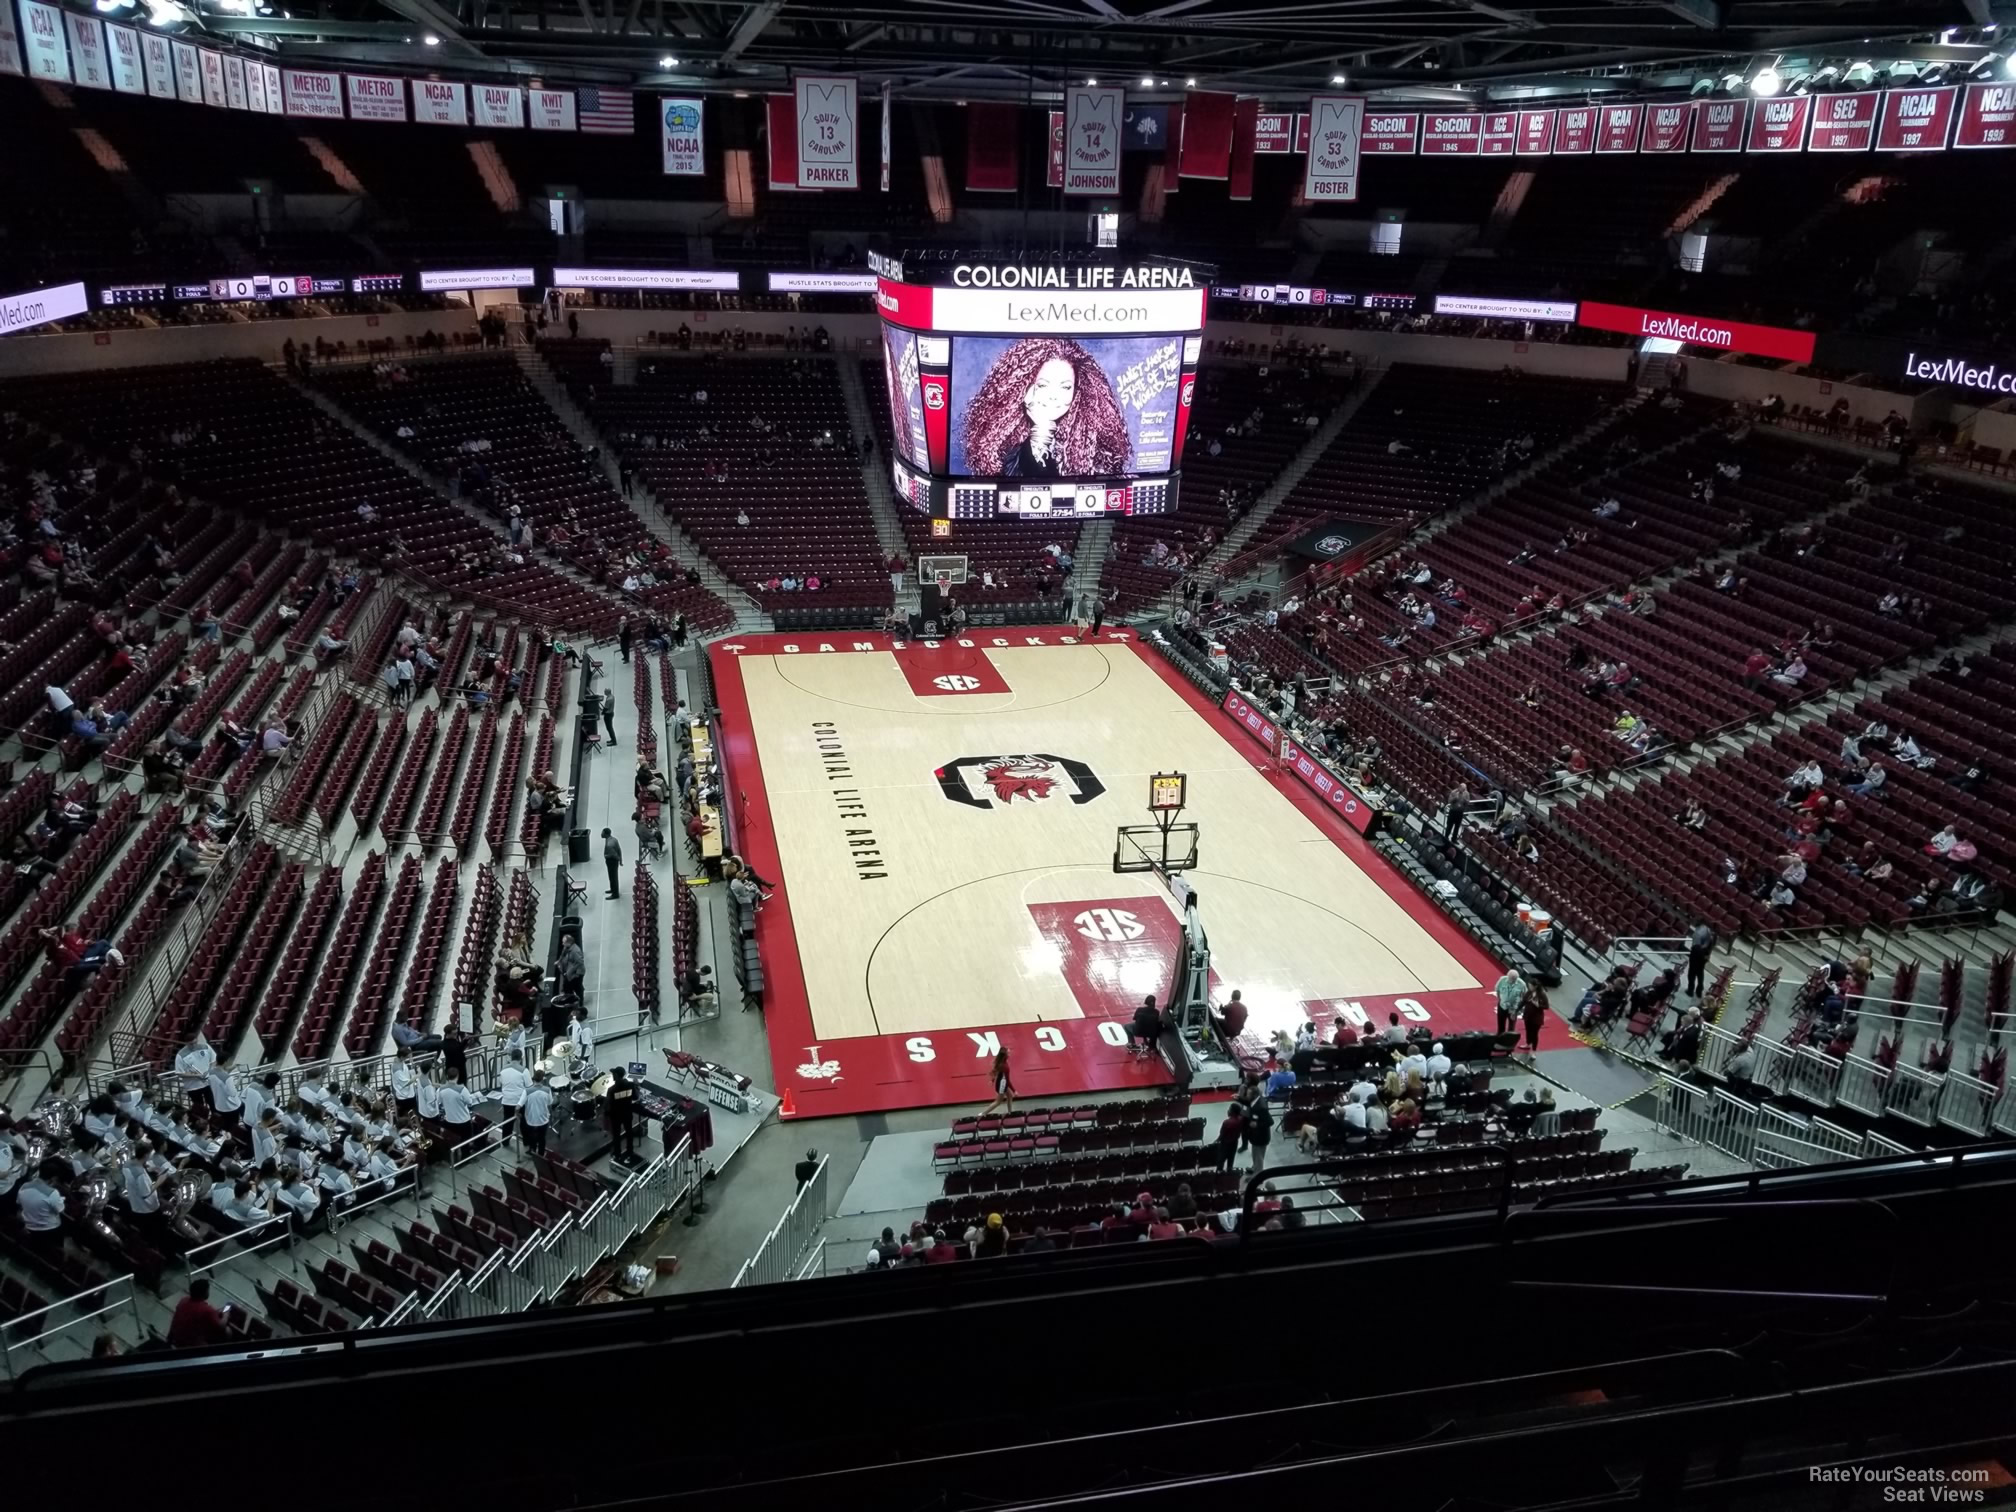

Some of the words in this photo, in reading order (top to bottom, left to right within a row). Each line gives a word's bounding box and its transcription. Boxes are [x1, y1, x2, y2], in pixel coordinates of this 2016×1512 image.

[28, 6, 56, 38] NCAA
[293, 74, 331, 93] METRO
[358, 79, 394, 96] METRO
[425, 84, 454, 101] NCAA
[485, 89, 510, 105] AIAW
[541, 94, 563, 108] NWIT
[1898, 94, 1937, 117] NCAA
[1707, 104, 1734, 123] NCAA
[1764, 102, 1794, 123] NCAA
[1833, 98, 1858, 120] SEC
[813, 113, 841, 125] SOUTH
[1493, 117, 1507, 132] ACC
[1529, 115, 1544, 131] ACC
[1566, 112, 1588, 129] NCAA
[1609, 109, 1632, 127] NCAA
[1656, 108, 1681, 126] NCAA
[1900, 117, 1931, 127] TOURNAMENT
[1081, 122, 1107, 134] SOUTH
[1370, 118, 1407, 132] SoCON
[1435, 118, 1472, 133] SoCON
[819, 126, 835, 140] 13
[1324, 130, 1348, 141] SOUTH
[1831, 135, 1849, 146] 1997
[1902, 133, 1922, 145] 1997
[1983, 129, 2005, 142] 1998
[667, 138, 700, 153] NCAA
[808, 139, 846, 155] CAROLINA
[1086, 134, 1101, 148] 14
[1378, 142, 1394, 150] 1934
[1442, 143, 1458, 151] 1945
[1709, 137, 1724, 147] 1974
[1075, 147, 1111, 162] CAROLINA
[1328, 143, 1342, 155] 53
[675, 162, 693, 170] 2015
[1317, 155, 1350, 170] CAROLINA
[806, 168, 849, 182] PARKER
[1068, 175, 1116, 189] JOHNSON
[1314, 182, 1349, 194] FOSTER
[953, 265, 1071, 288] COLONIAL
[1078, 266, 1113, 288] LIFE
[1120, 267, 1194, 288] ARENA
[237, 282, 247, 296] 0
[278, 280, 288, 294] 0
[1261, 288, 1269, 299] 0
[1295, 290, 1304, 302] 0
[1008, 302, 1148, 321] LexMed.com
[1641, 314, 1731, 346] LexMed.com
[1147, 368, 1160, 385] OF
[1030, 495, 1042, 510] 0
[1085, 494, 1097, 509] 0
[1052, 509, 1074, 517] 27:54
[934, 526, 949, 537] 30
[932, 674, 981, 691] SEC
[812, 722, 853, 781] COLONIAL
[1966, 768, 1981, 779] 15
[833, 789, 868, 819] LIFE
[845, 829, 889, 880] ARENA
[1073, 907, 1146, 942] SEC
[709, 1085, 739, 1113] DEFENSE
